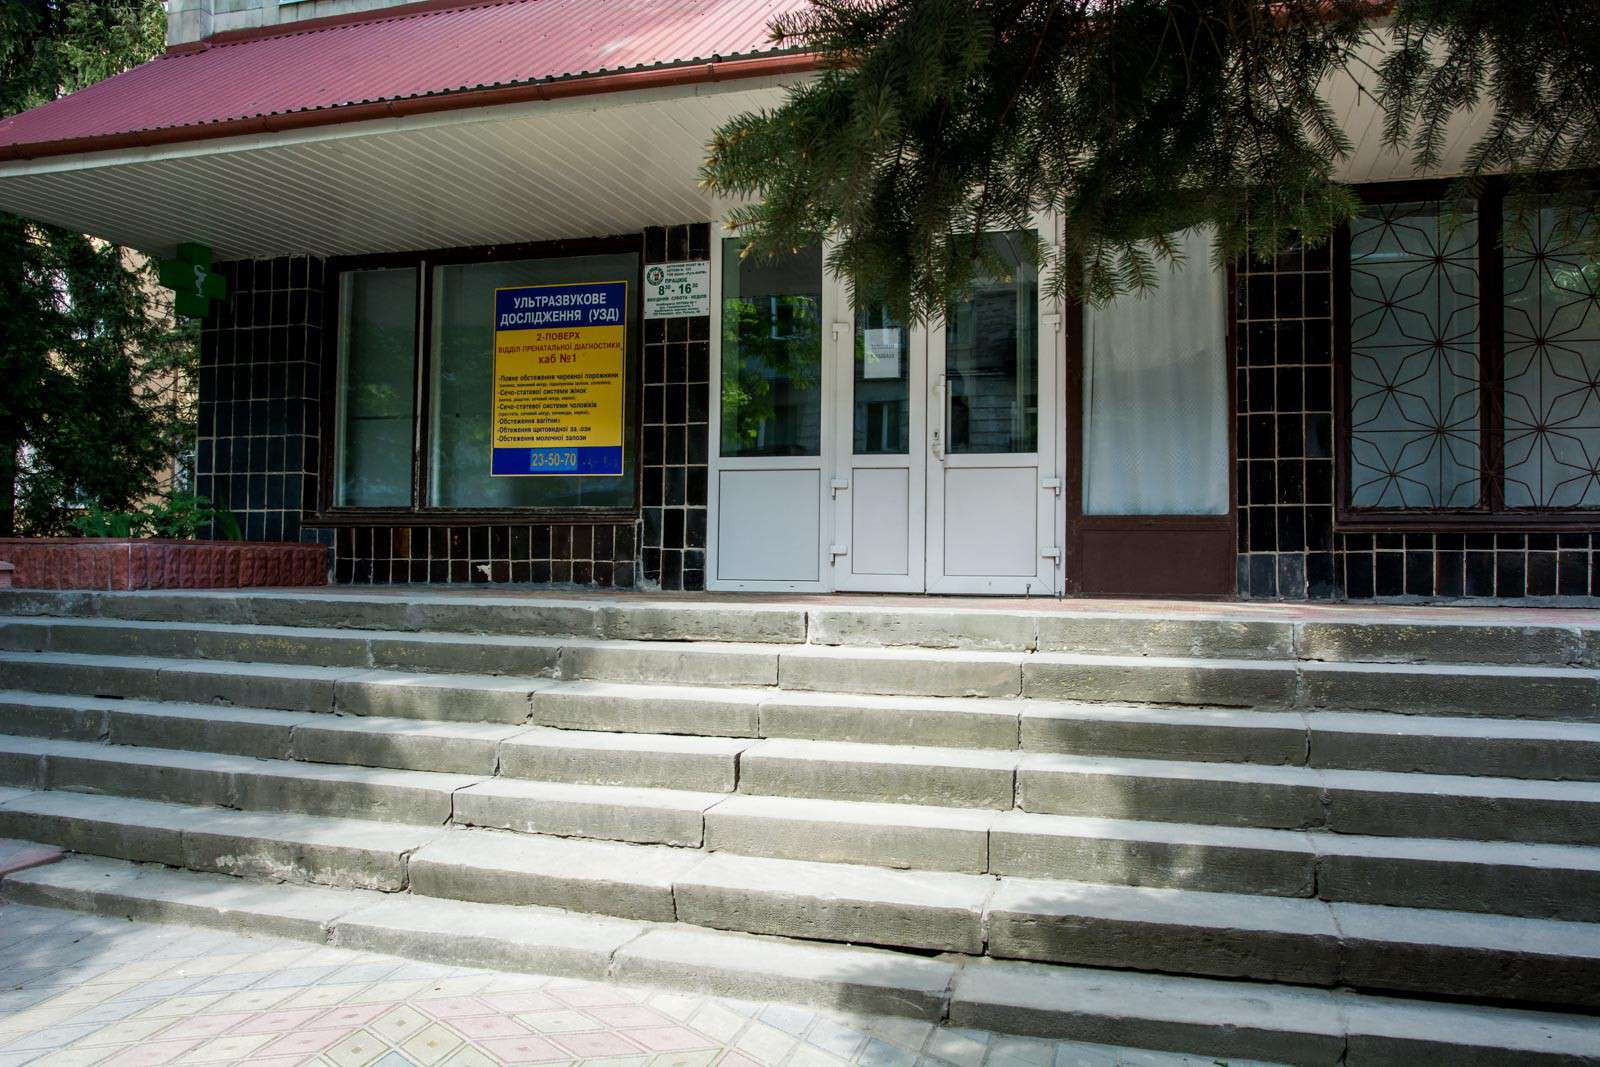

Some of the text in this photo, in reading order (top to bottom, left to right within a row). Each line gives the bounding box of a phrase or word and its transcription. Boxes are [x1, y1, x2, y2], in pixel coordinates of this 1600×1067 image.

[514, 293, 607, 309] УЛЬТРАЗВУКОВЕ
[500, 308, 619, 326] ДОСЛІДЖЕННЯ (УЗД)
[536, 332, 581, 342] 2-ПОВЕРХ
[498, 346, 520, 354] ВІДДІЛ
[522, 344, 572, 352] ПРЕНАТАЛЬНОЇ
[538, 354, 556, 364] каб
[532, 453, 576, 466] 23-50-70
